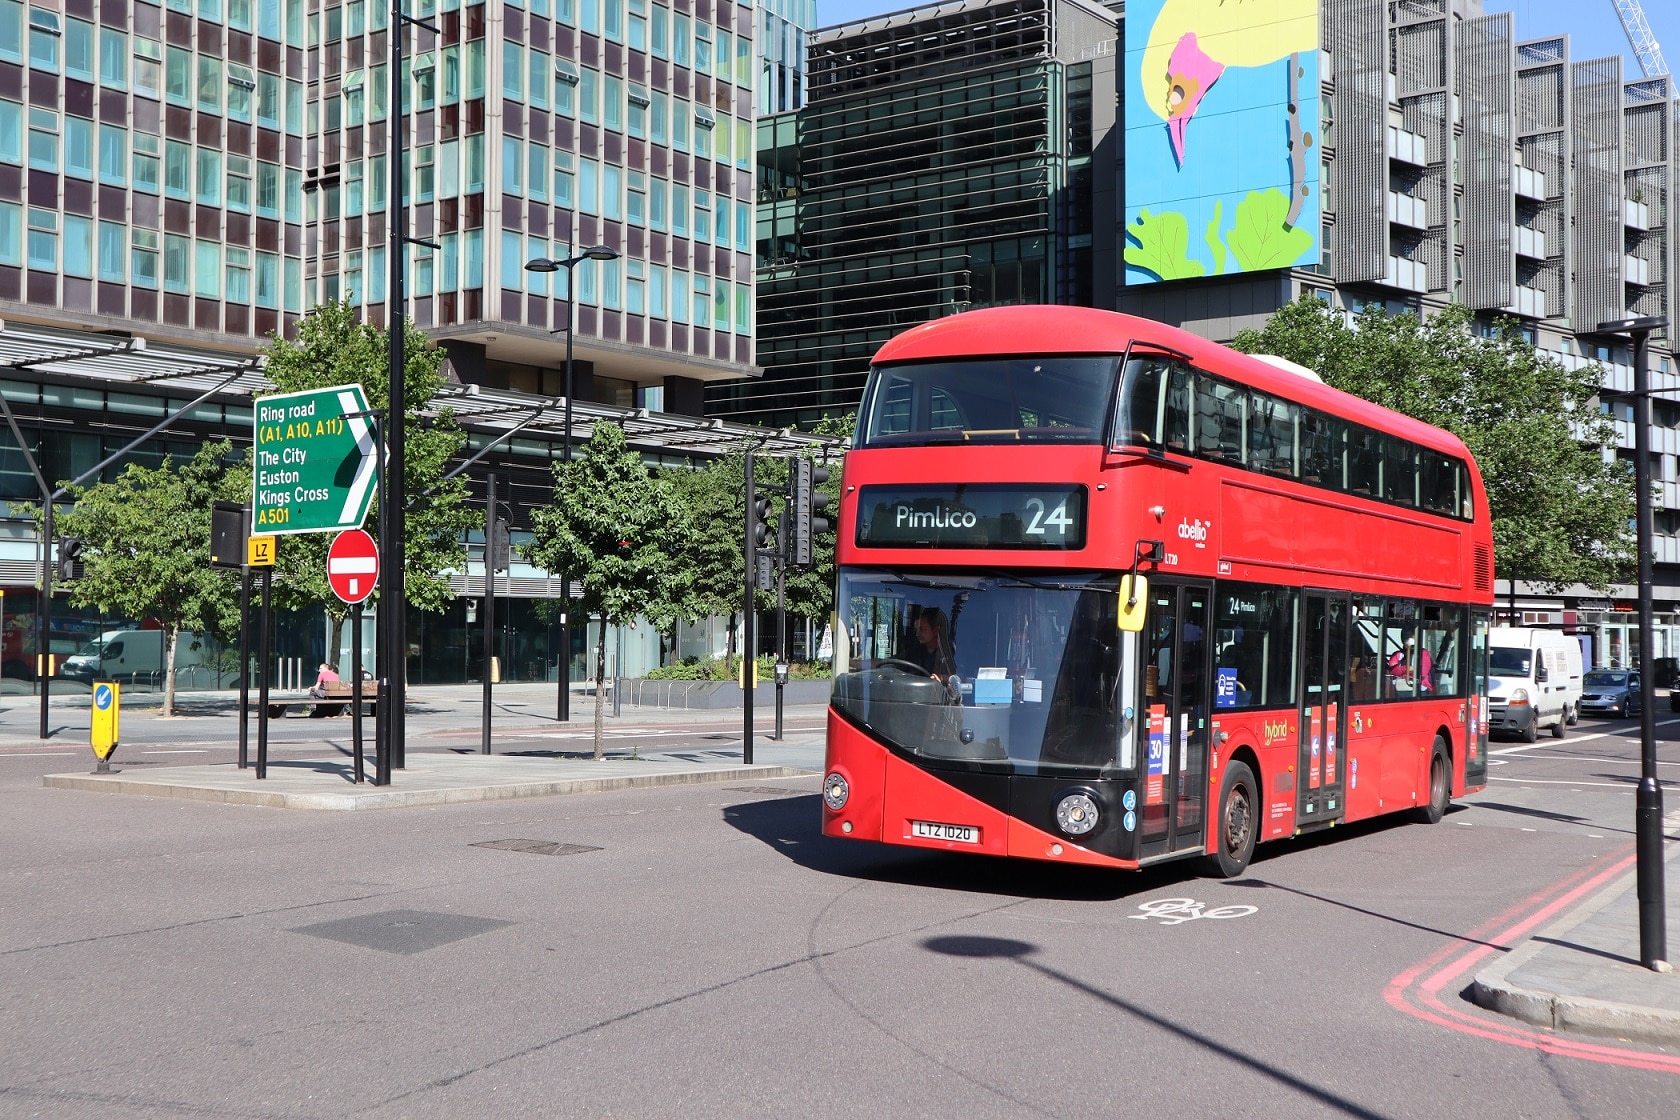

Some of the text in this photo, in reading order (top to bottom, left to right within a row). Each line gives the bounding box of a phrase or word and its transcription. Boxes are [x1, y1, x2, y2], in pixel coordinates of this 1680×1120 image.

[260, 400, 315, 423] Ring road
[260, 417, 343, 444] (A1, A10, A11)
[259, 448, 307, 466] The City
[260, 469, 300, 486] Euston
[259, 486, 329, 506] Kings Cross
[258, 508, 290, 525] A501
[896, 497, 1073, 535] Pimlico 24
[1177, 516, 1207, 541] abellio
[255, 543, 268, 557] LZ
[1229, 597, 1256, 615] 24 Pimlico
[1264, 719, 1288, 746] hybrid
[1150, 739, 1162, 760] 30
